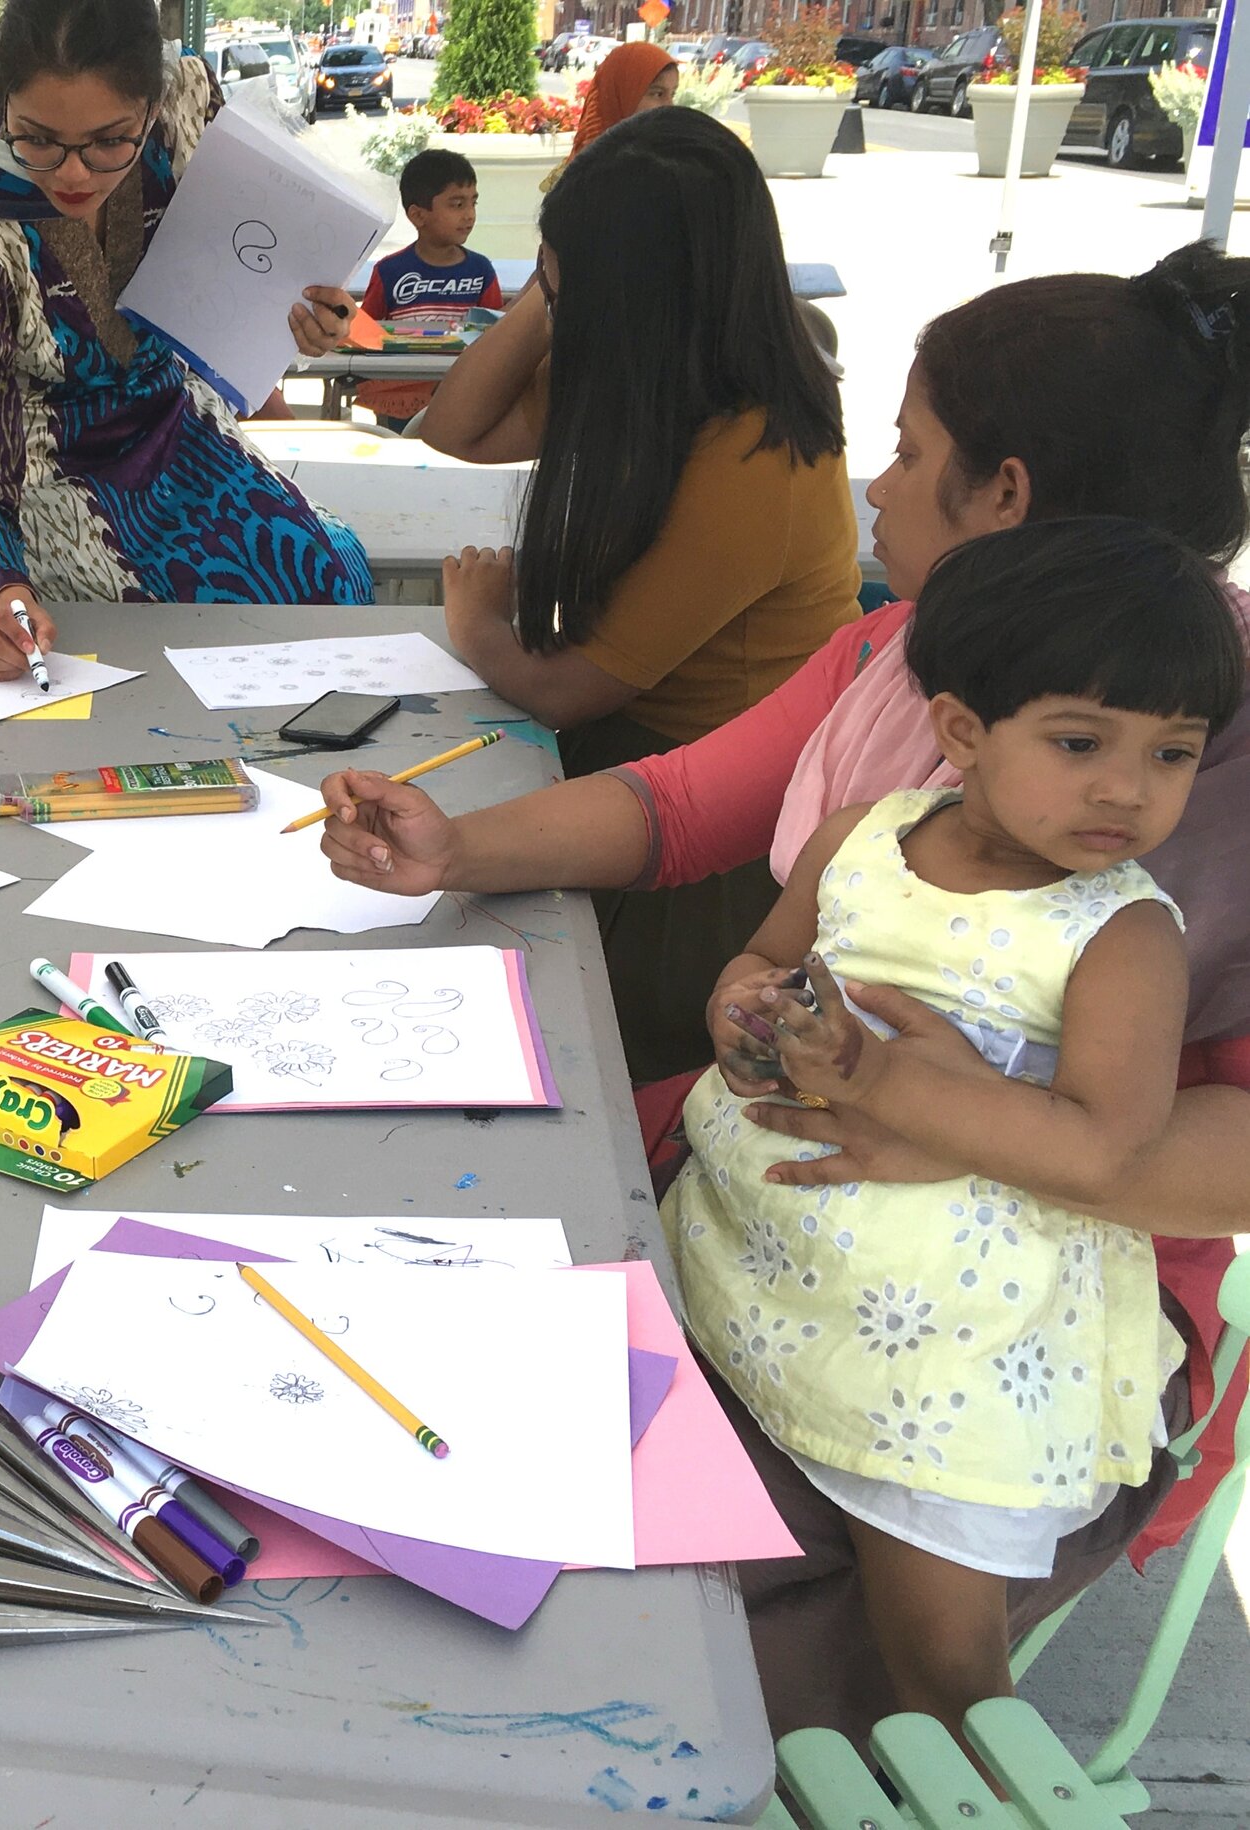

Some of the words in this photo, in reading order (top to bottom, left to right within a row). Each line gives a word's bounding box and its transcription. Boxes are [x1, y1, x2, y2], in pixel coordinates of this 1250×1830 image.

[97, 1036, 125, 1050] 10
[10, 1031, 166, 1087] MARKERS
[31, 1062, 42, 1071] by
[42, 1066, 84, 1083] Preferred
[16, 1162, 51, 1178] Classic
[25, 1158, 60, 1174] Colors
[53, 1172, 87, 1186] 10
[59, 1442, 104, 1479] Crayola
